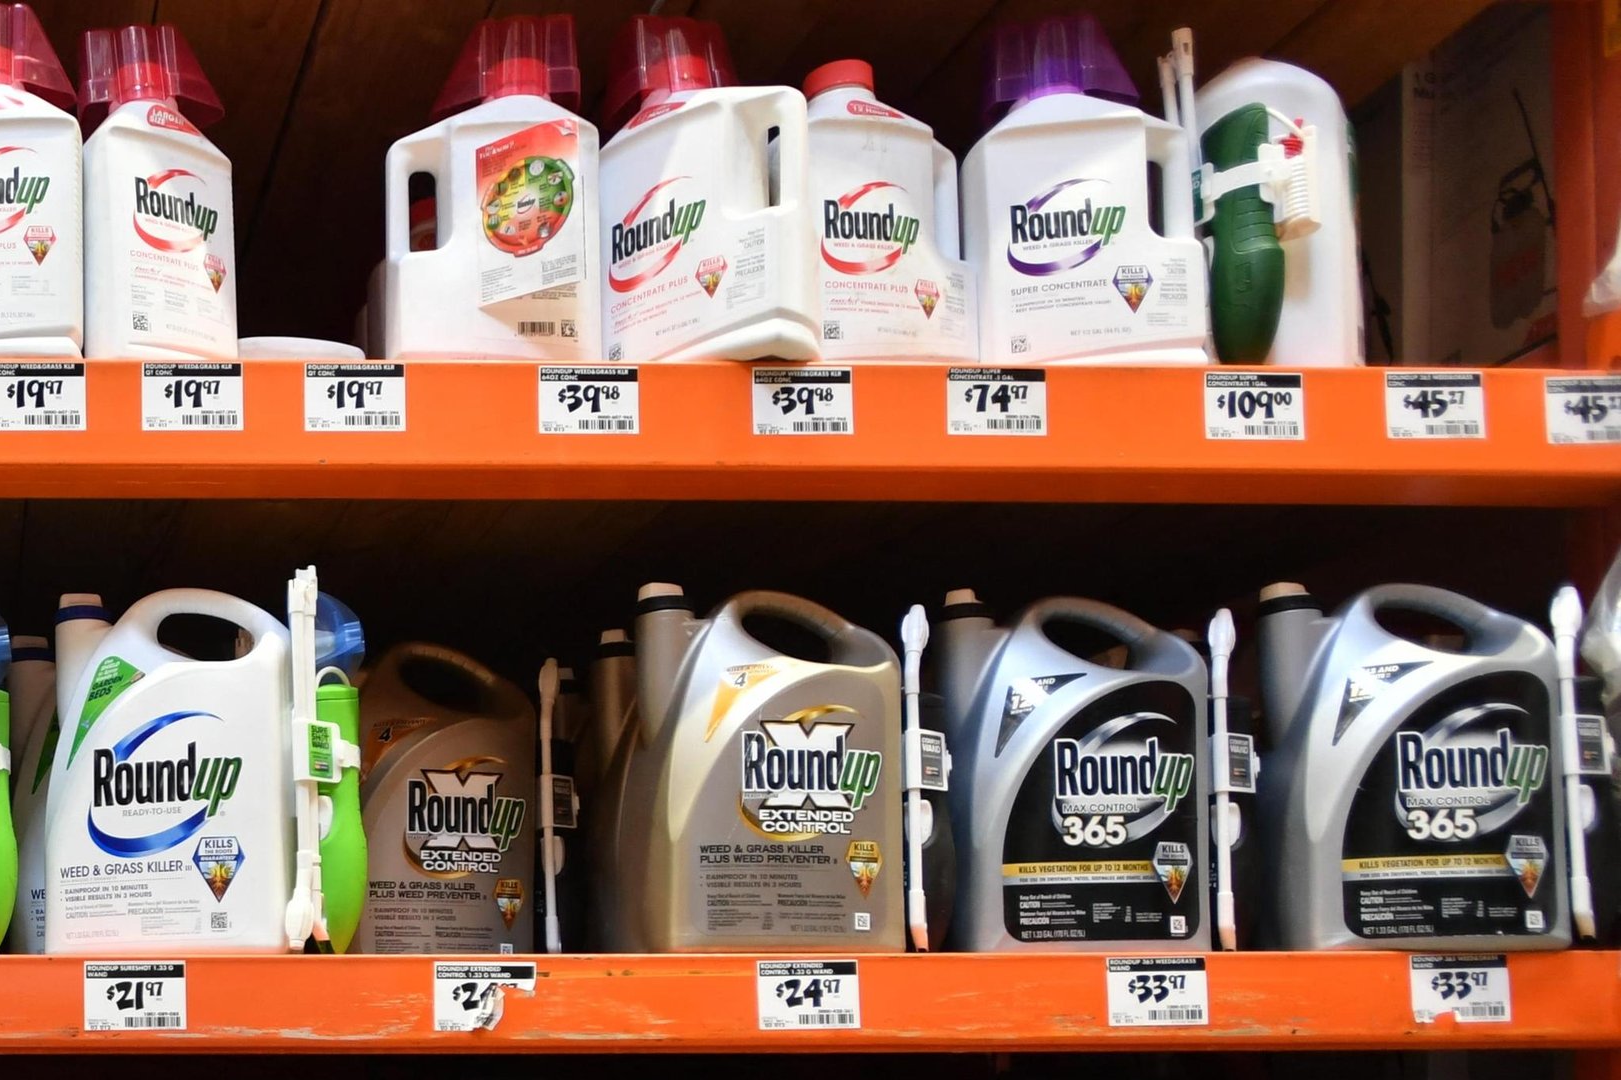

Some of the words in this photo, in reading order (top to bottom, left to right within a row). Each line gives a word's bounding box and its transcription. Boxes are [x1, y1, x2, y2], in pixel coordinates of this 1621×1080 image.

[135, 176, 218, 241] Roundup
[612, 198, 706, 264] Roundup
[824, 200, 920, 254] Roundup
[1010, 198, 1126, 245] Roundup
[93, 742, 242, 818] Roundup
[742, 732, 881, 811] Roundup
[1055, 737, 1194, 813] Roundup
[1397, 728, 1548, 805] Roundup
[408, 779, 526, 852] Roundup
[759, 809, 854, 822] EXTENDED
[762, 821, 852, 835] CONTROL
[1063, 803, 1087, 813] MAX
[1090, 803, 1140, 813] CONTROL
[1063, 816, 1127, 846] 365
[1407, 809, 1478, 840] 365
[700, 855, 730, 865] PLUS
[733, 855, 764, 865] WEED
[768, 855, 830, 865] PREVENTER
[1162, 844, 1185, 854] KILLS
